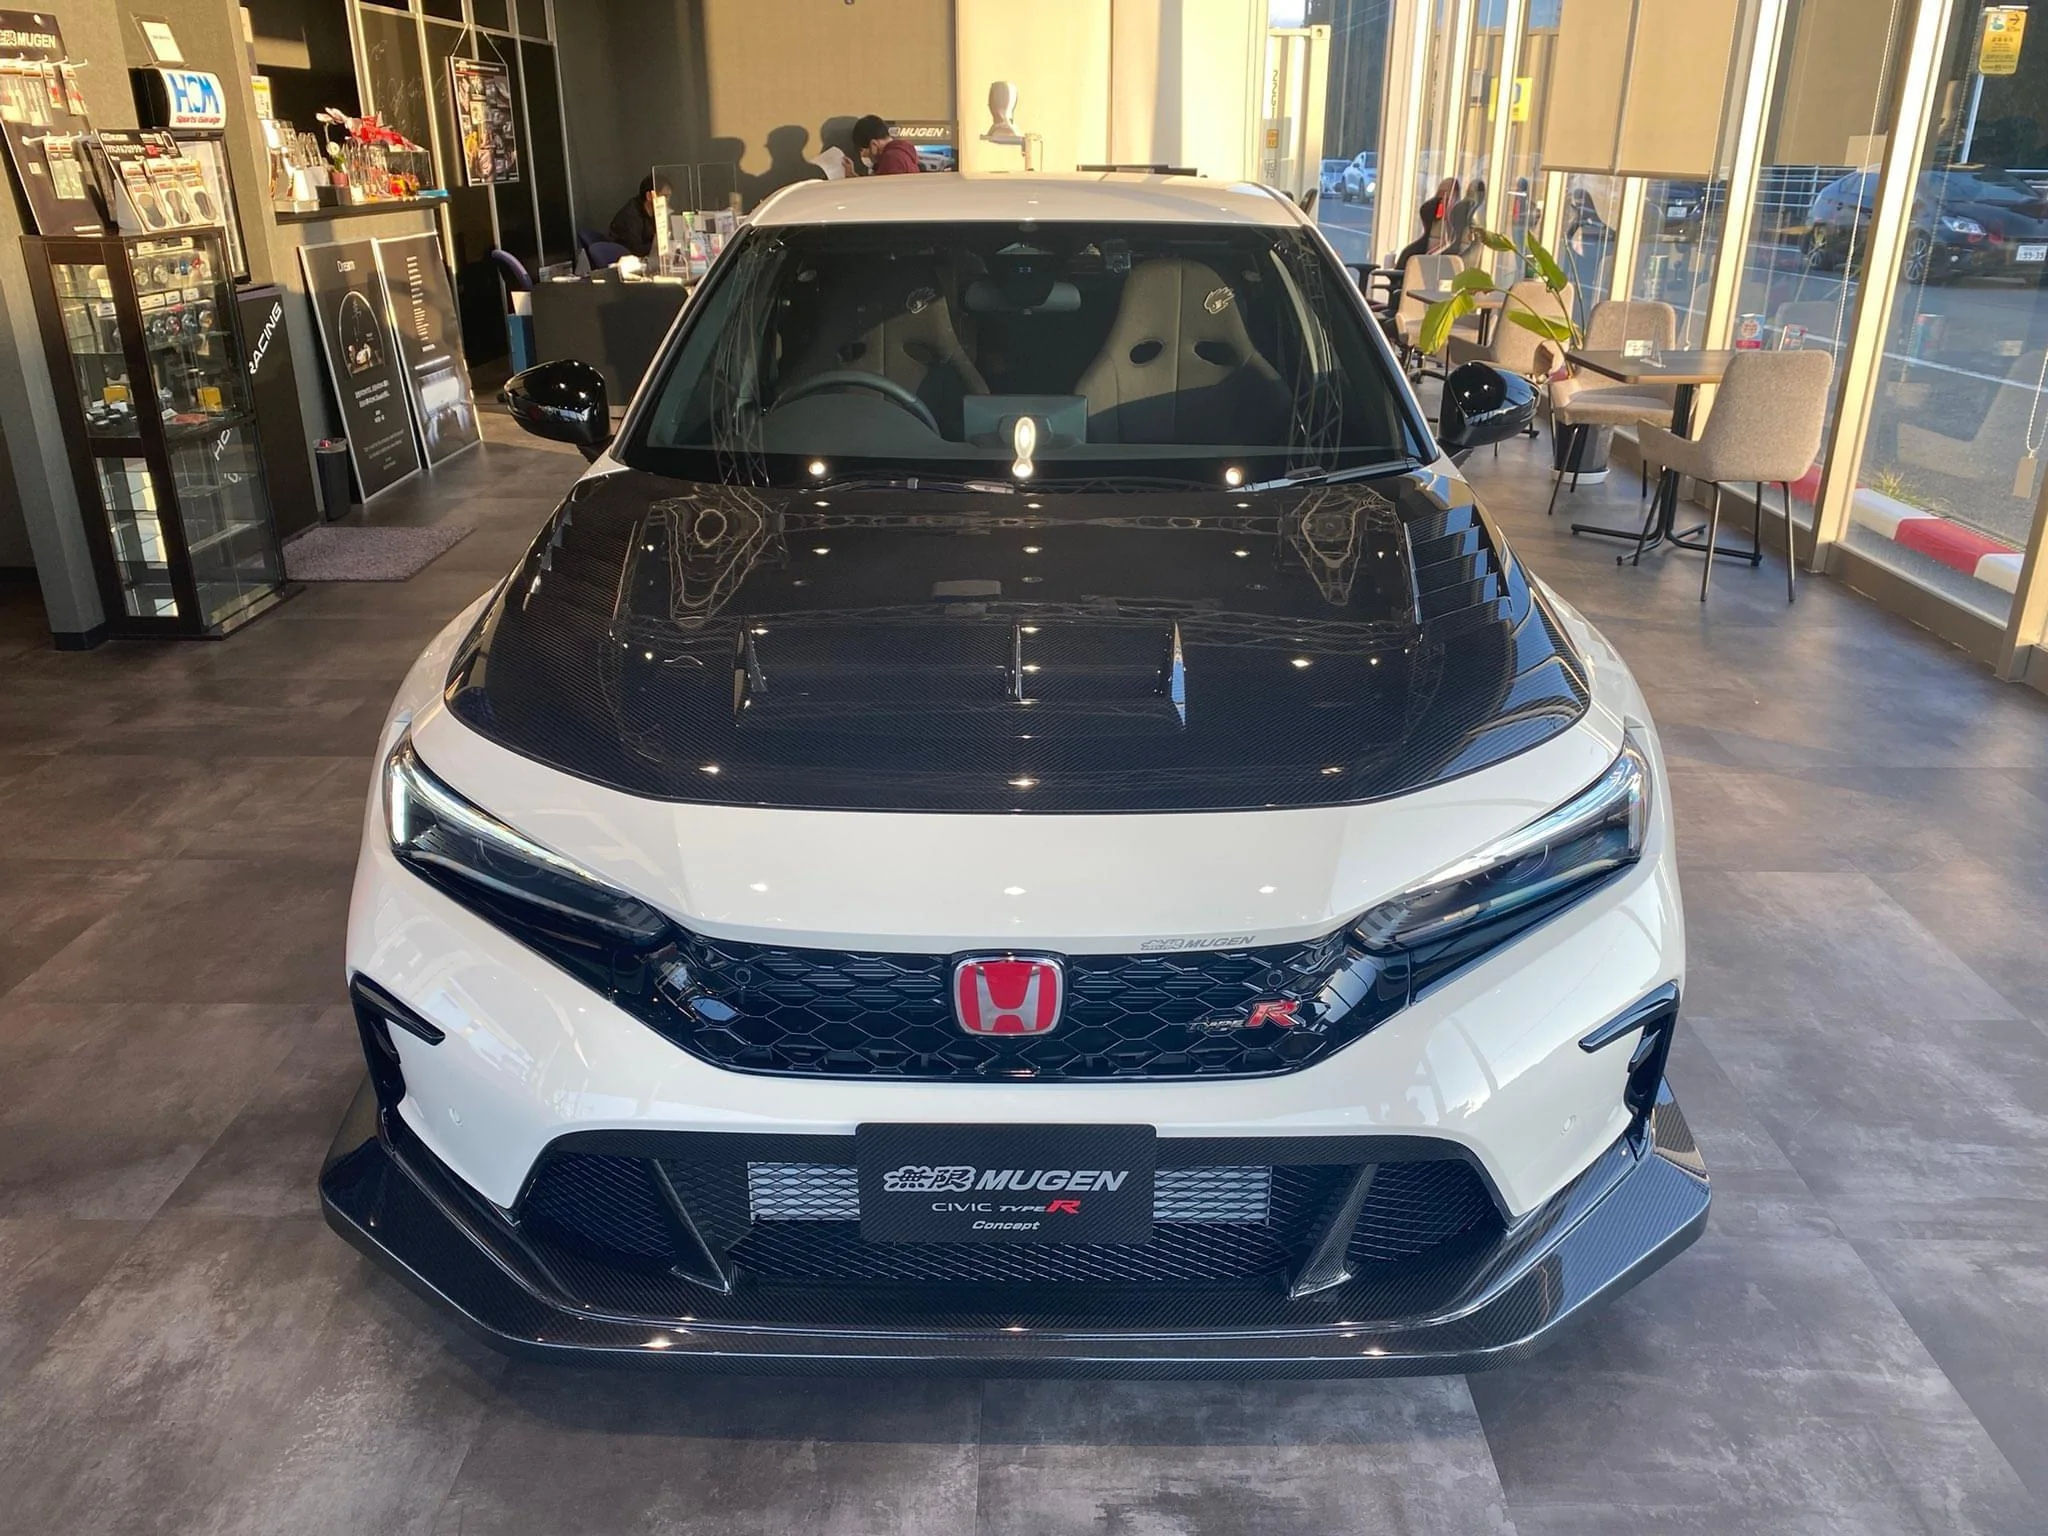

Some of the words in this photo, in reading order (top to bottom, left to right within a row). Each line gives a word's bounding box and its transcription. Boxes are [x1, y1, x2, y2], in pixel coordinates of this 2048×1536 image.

[17, 31, 56, 48] MUGEN
[900, 127, 944, 137] MUGEN
[249, 301, 283, 374] RACING
[1184, 935, 1256, 949] MUGEN
[884, 1165, 977, 1193] 無限
[976, 1169, 1129, 1192] MUGEN
[931, 1202, 993, 1212] CIVIC
[972, 1220, 1040, 1231] Concept
